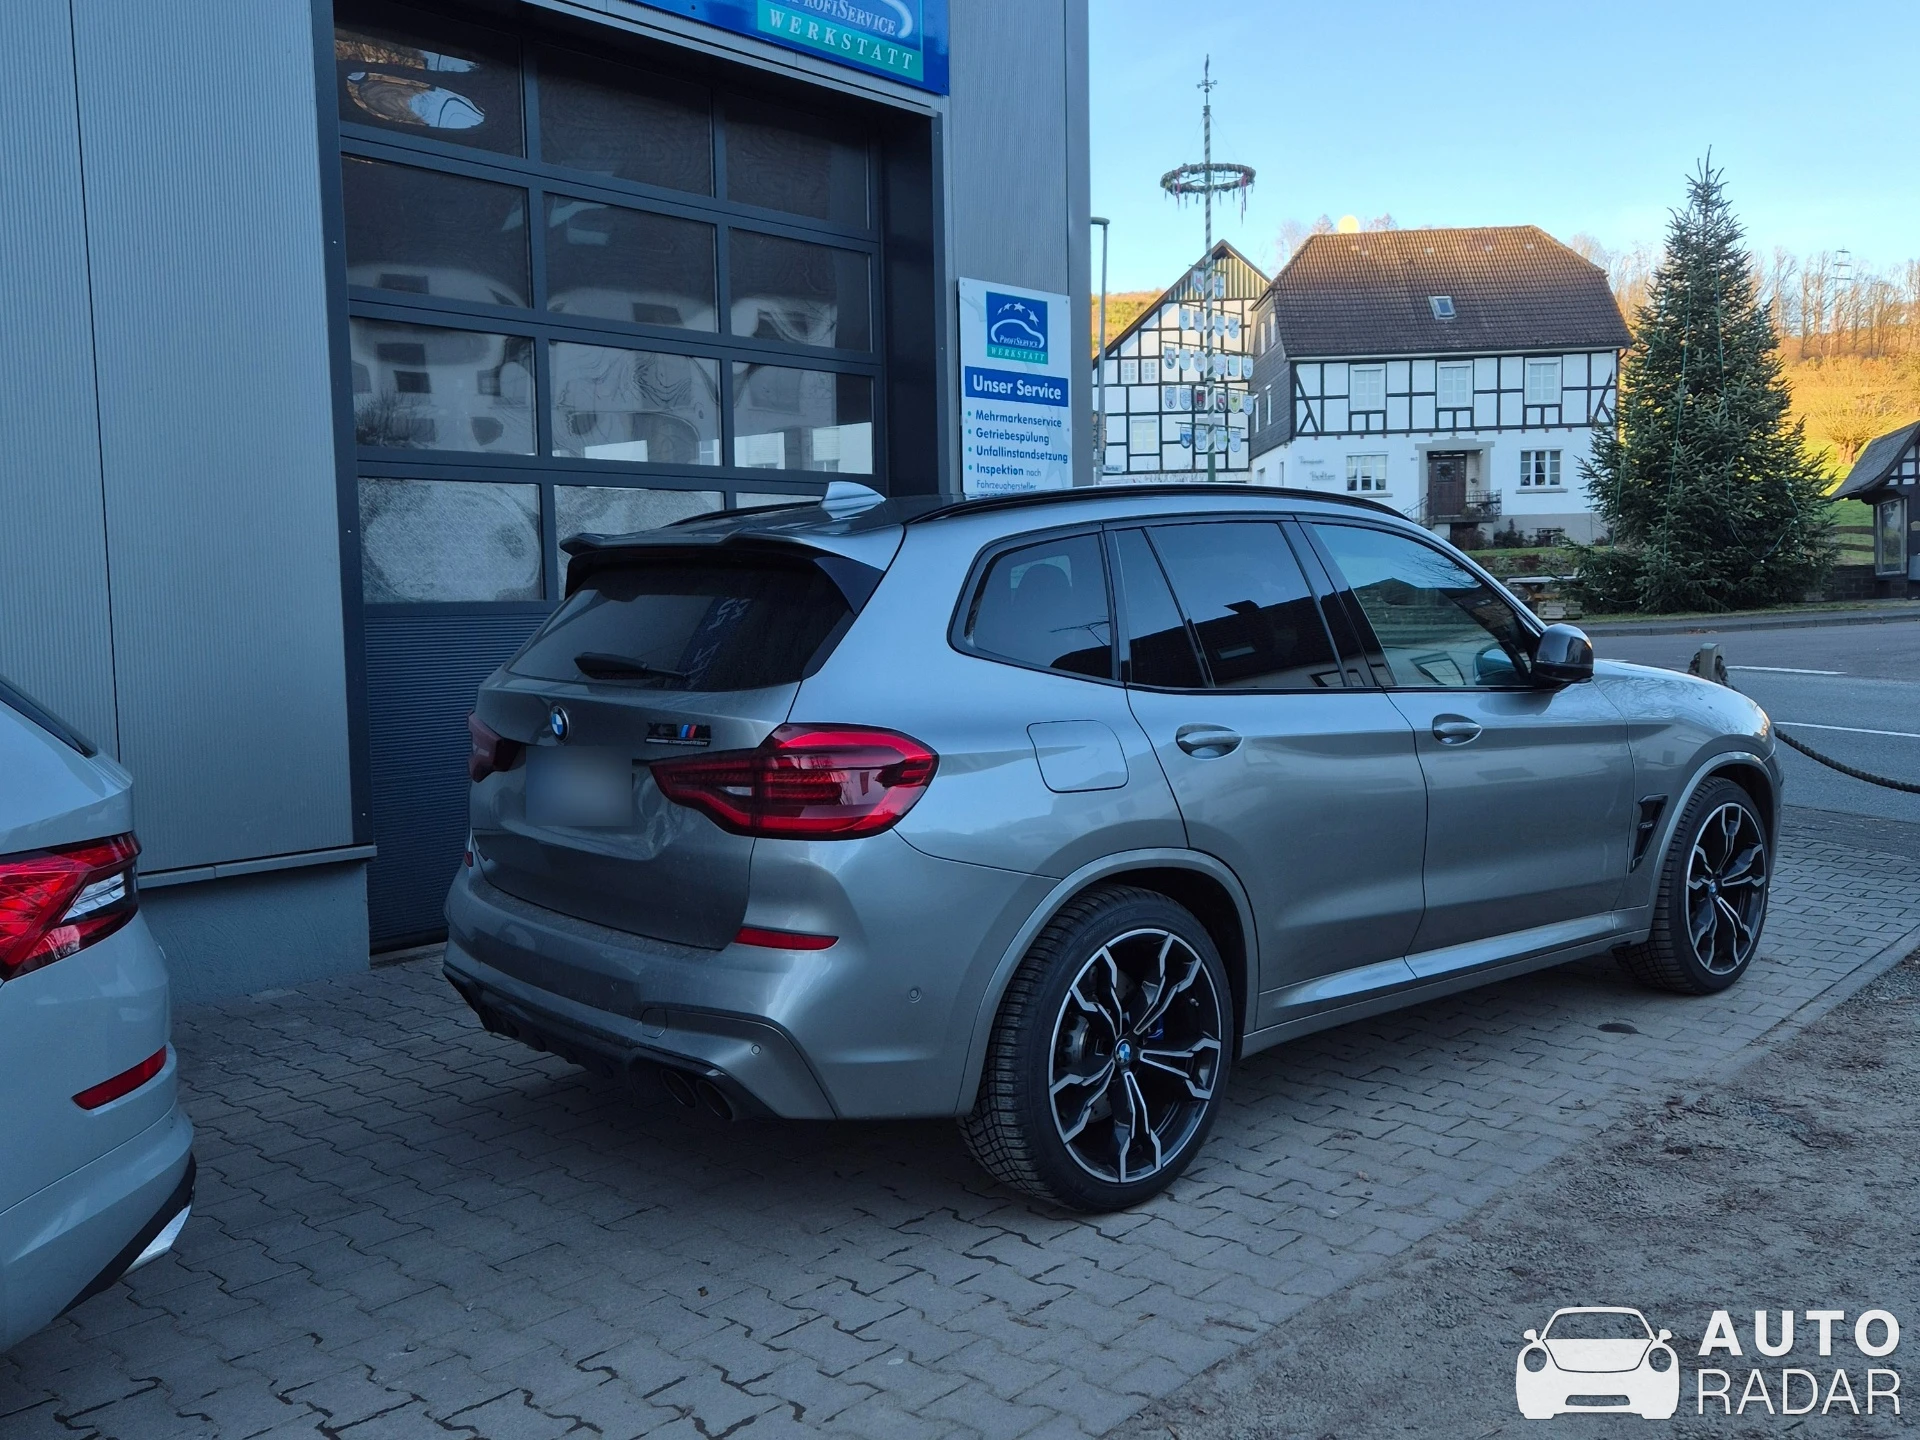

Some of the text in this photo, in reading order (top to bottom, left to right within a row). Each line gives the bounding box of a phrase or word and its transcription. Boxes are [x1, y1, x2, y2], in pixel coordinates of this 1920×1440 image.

[786, 0, 897, 36] ROFISERVICE
[769, 8, 913, 70] WERKSTATT
[991, 346, 1045, 361] WERKSTATT
[973, 374, 1062, 400] Unser Service
[975, 410, 1062, 428] Mehrmarkenservice
[976, 427, 1050, 446] Getriebespülung
[976, 445, 1068, 464] Unfallinstandsetzung
[976, 463, 1024, 477] Inspektion
